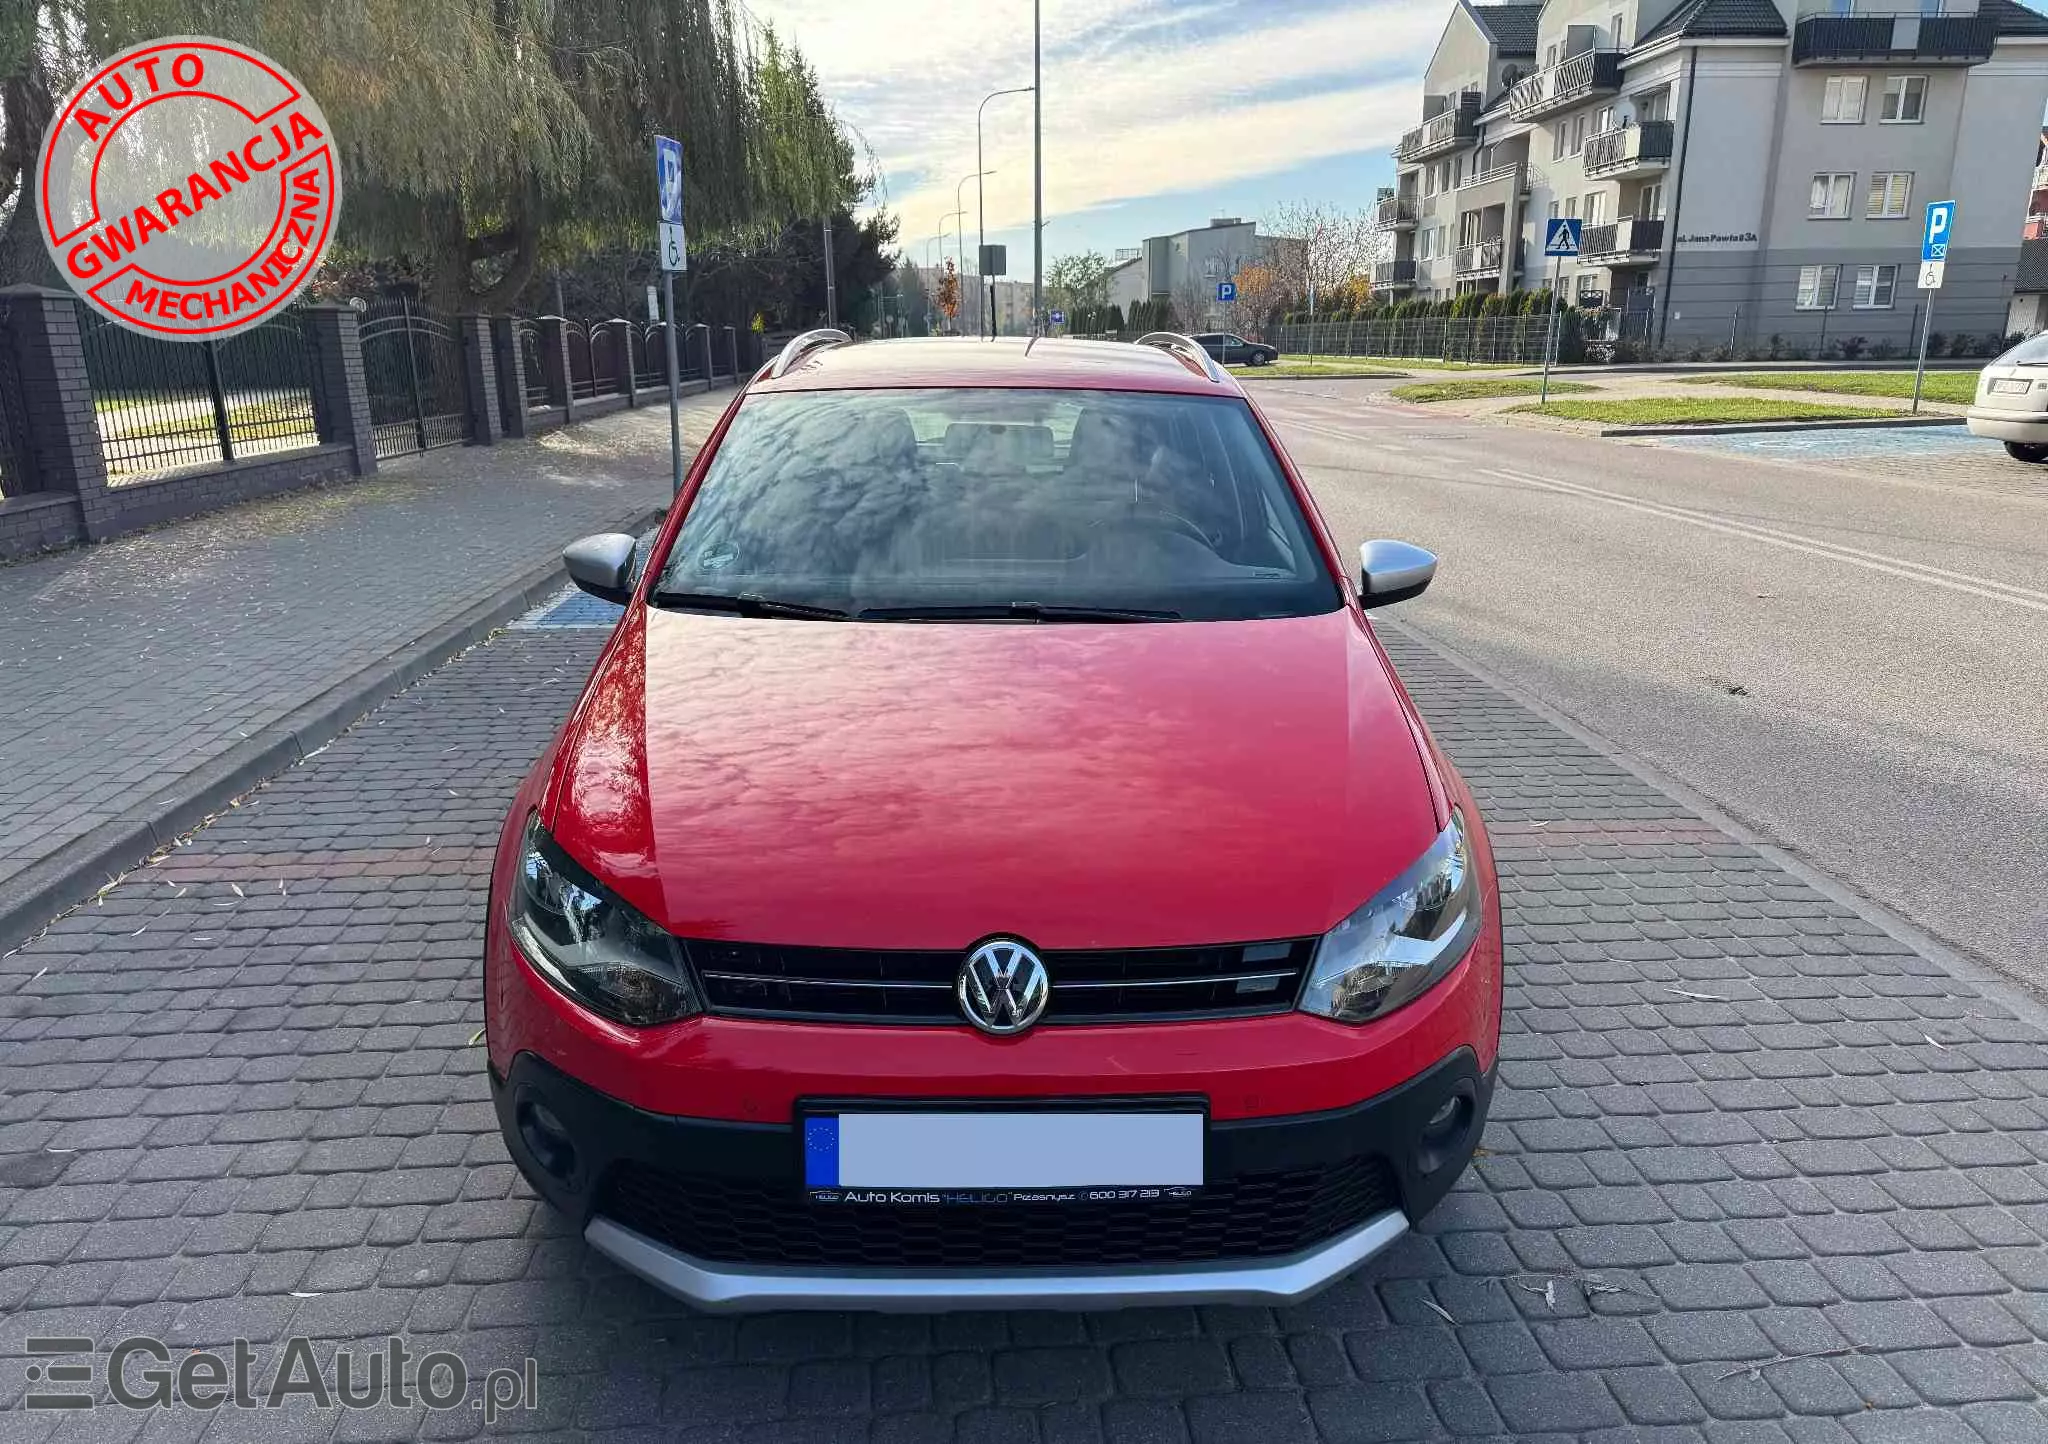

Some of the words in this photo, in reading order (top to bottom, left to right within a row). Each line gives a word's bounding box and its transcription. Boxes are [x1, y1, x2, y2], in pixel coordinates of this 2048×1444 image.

[1929, 207, 1948, 244] P
[1221, 285, 1232, 299] P
[844, 1191, 887, 1203] Auto
[890, 1191, 941, 1203] Komis
[1090, 1191, 1116, 1200] 600
